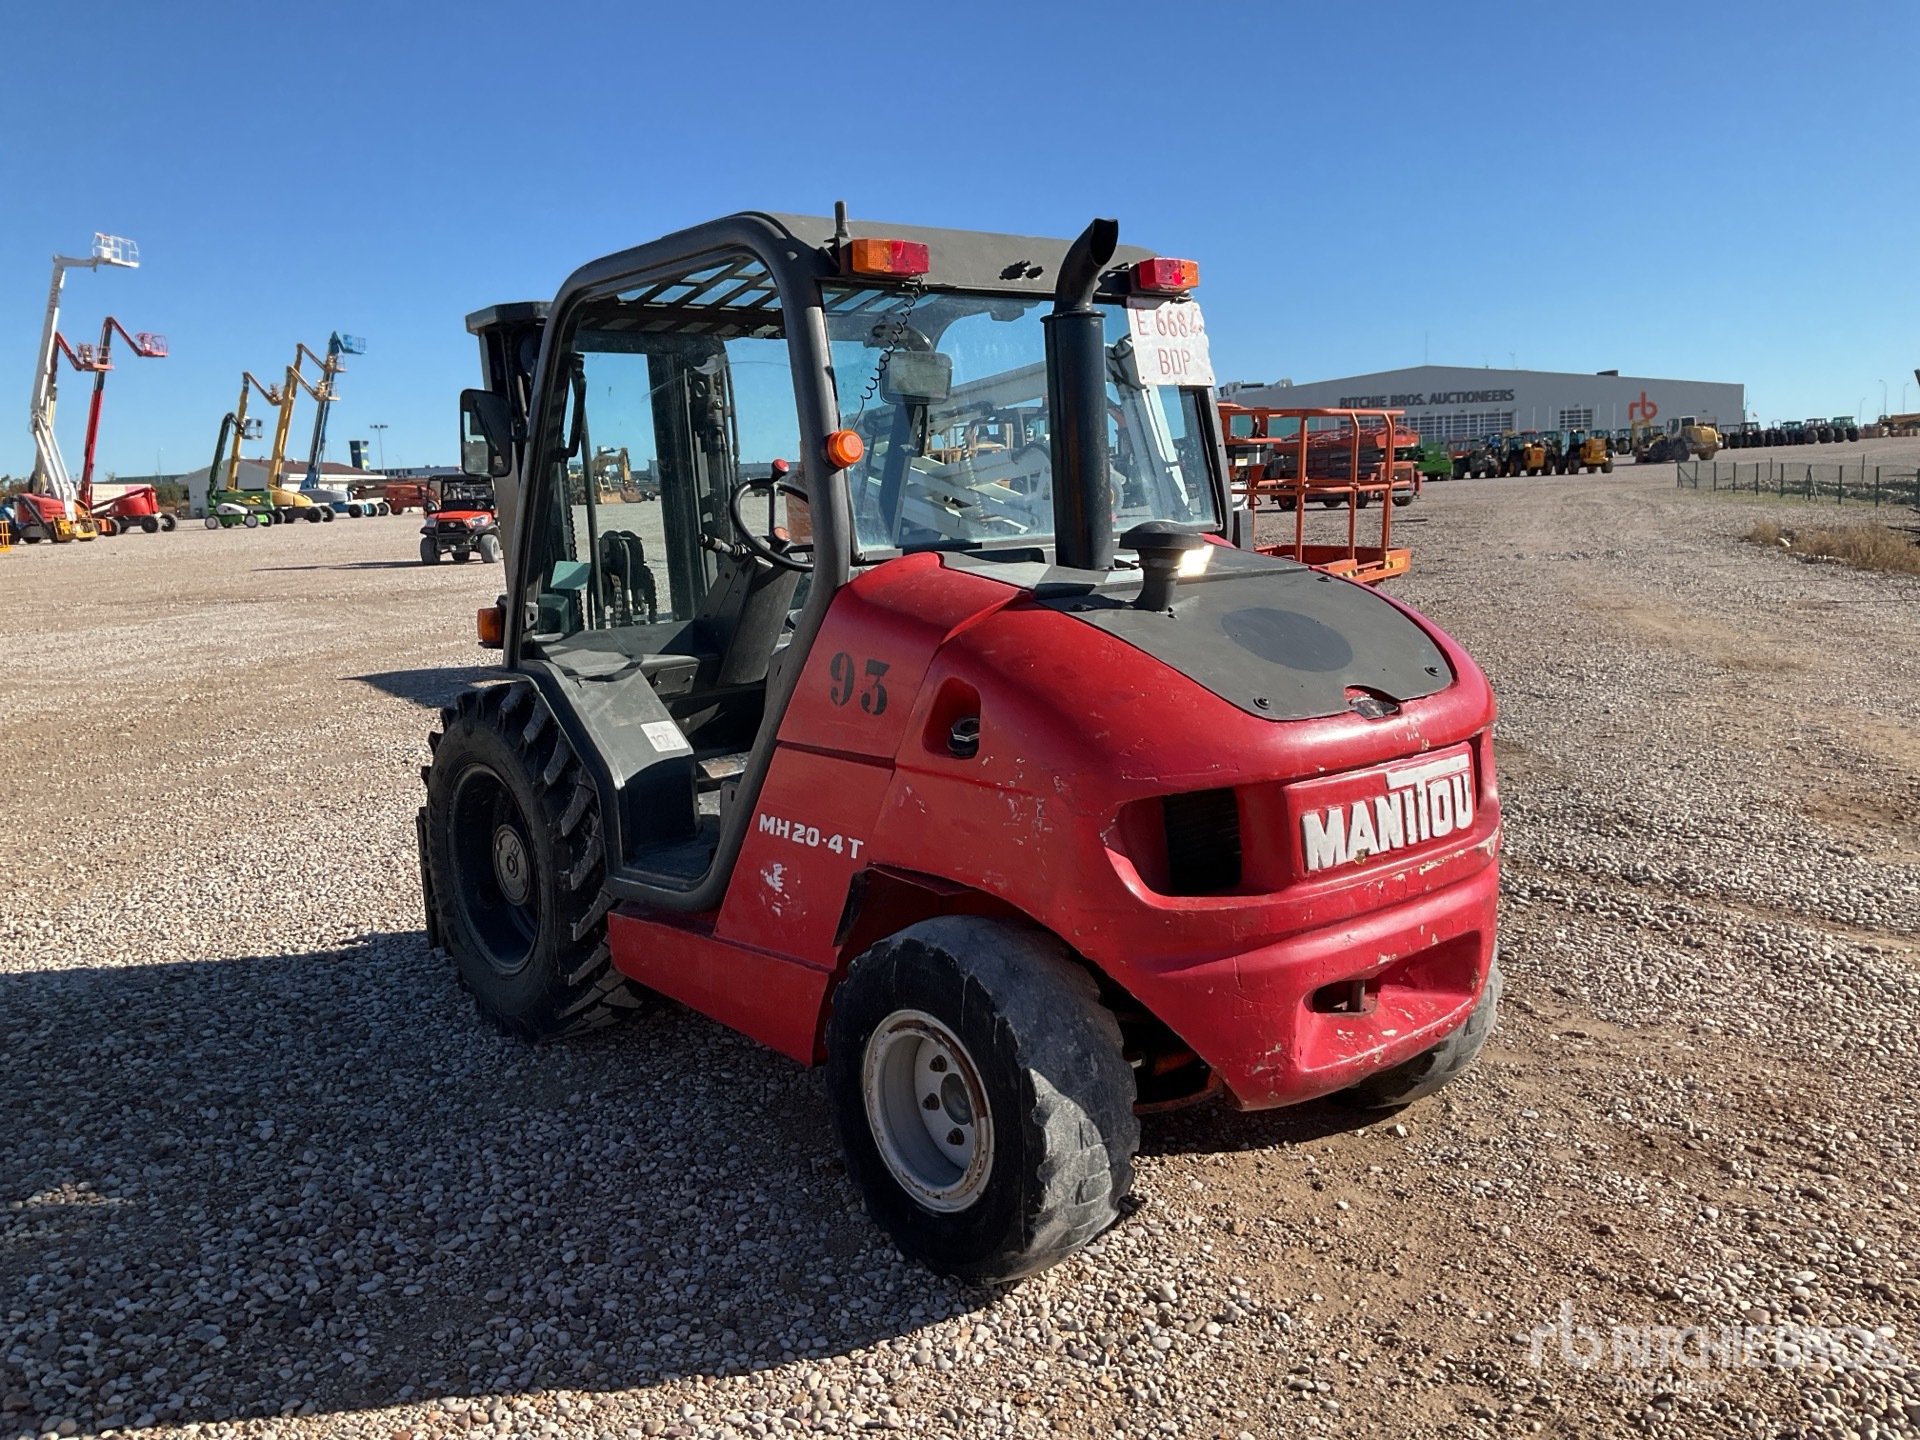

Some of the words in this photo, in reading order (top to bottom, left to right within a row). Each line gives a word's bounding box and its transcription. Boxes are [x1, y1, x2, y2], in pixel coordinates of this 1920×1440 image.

[1135, 308, 1150, 335] E
[1157, 347, 1191, 375] BDP
[1339, 396, 1387, 409] RITCHIE
[1390, 393, 1426, 407] BROS.
[1429, 389, 1515, 405] AUCTIONEERS
[1628, 391, 1658, 420] rb
[830, 652, 890, 716] 93
[1302, 753, 1474, 872] MANITOU
